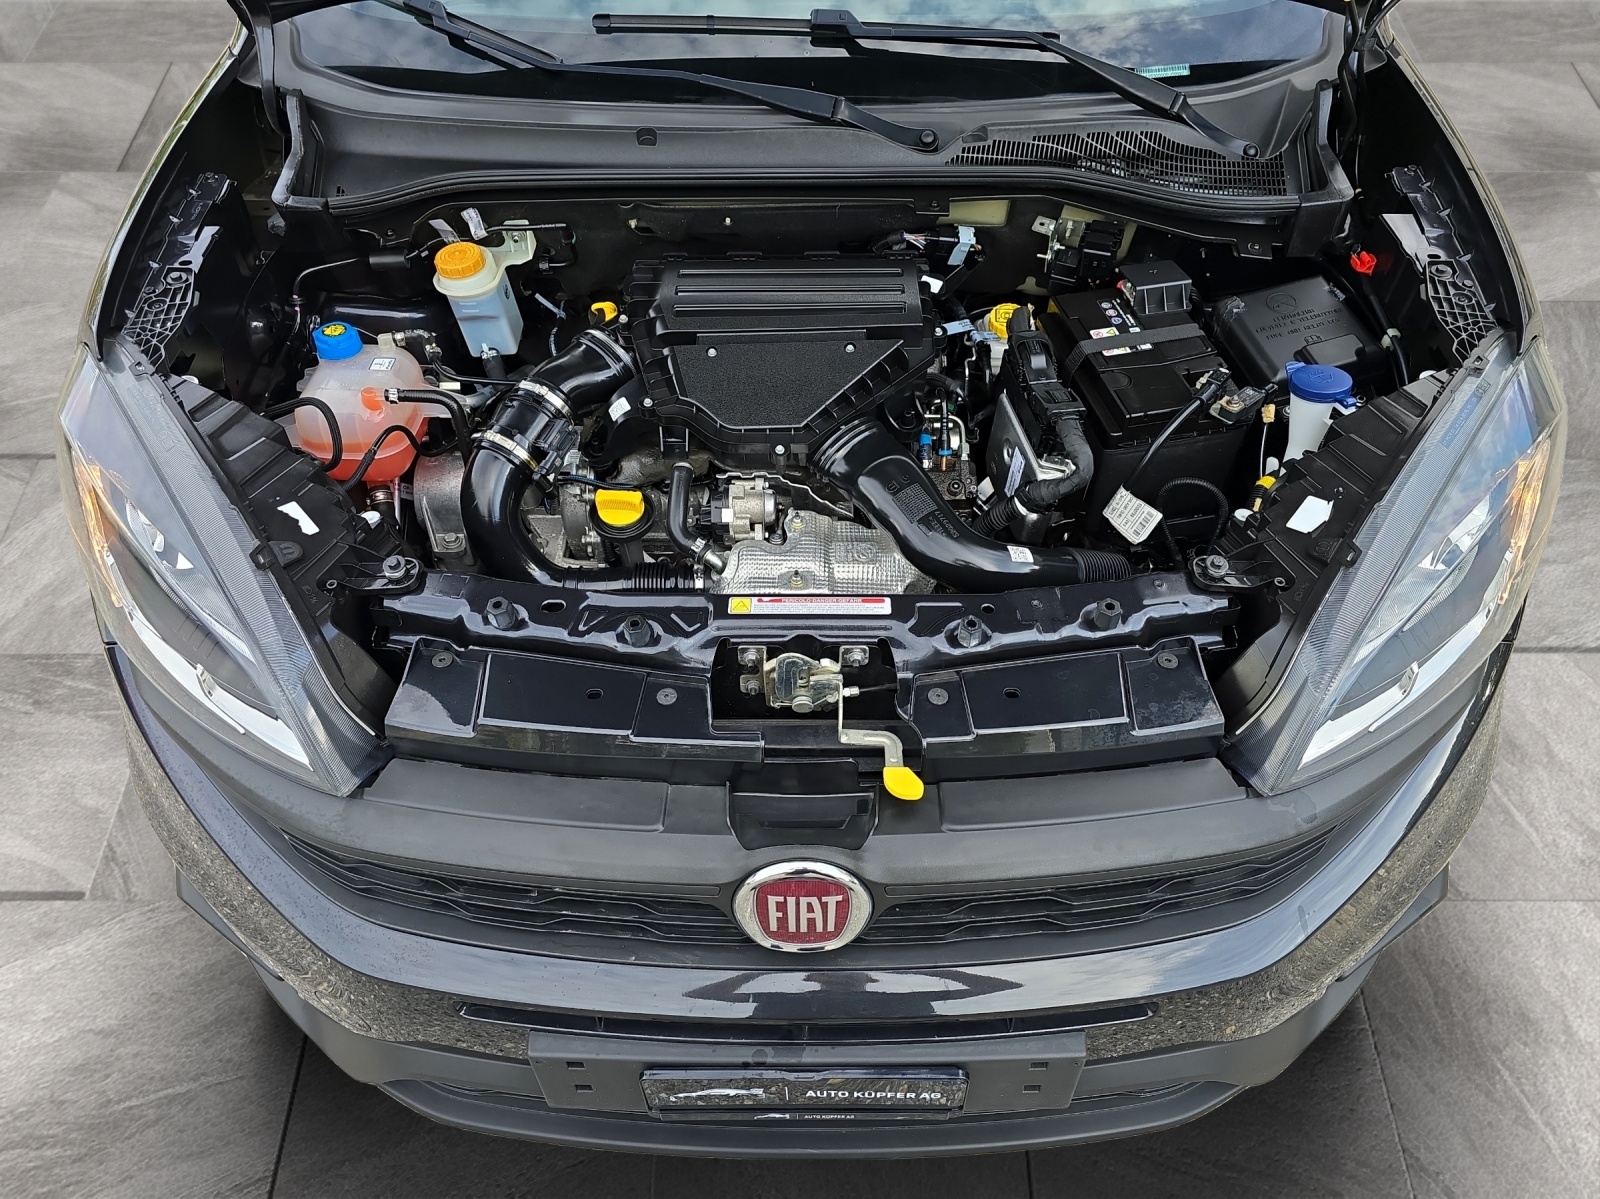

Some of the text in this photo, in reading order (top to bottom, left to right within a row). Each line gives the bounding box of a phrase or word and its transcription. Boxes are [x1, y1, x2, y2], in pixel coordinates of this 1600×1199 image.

[767, 895, 844, 933] FIAT
[805, 1090, 849, 1098] AUTO
[853, 1090, 916, 1099] KÜPFER
